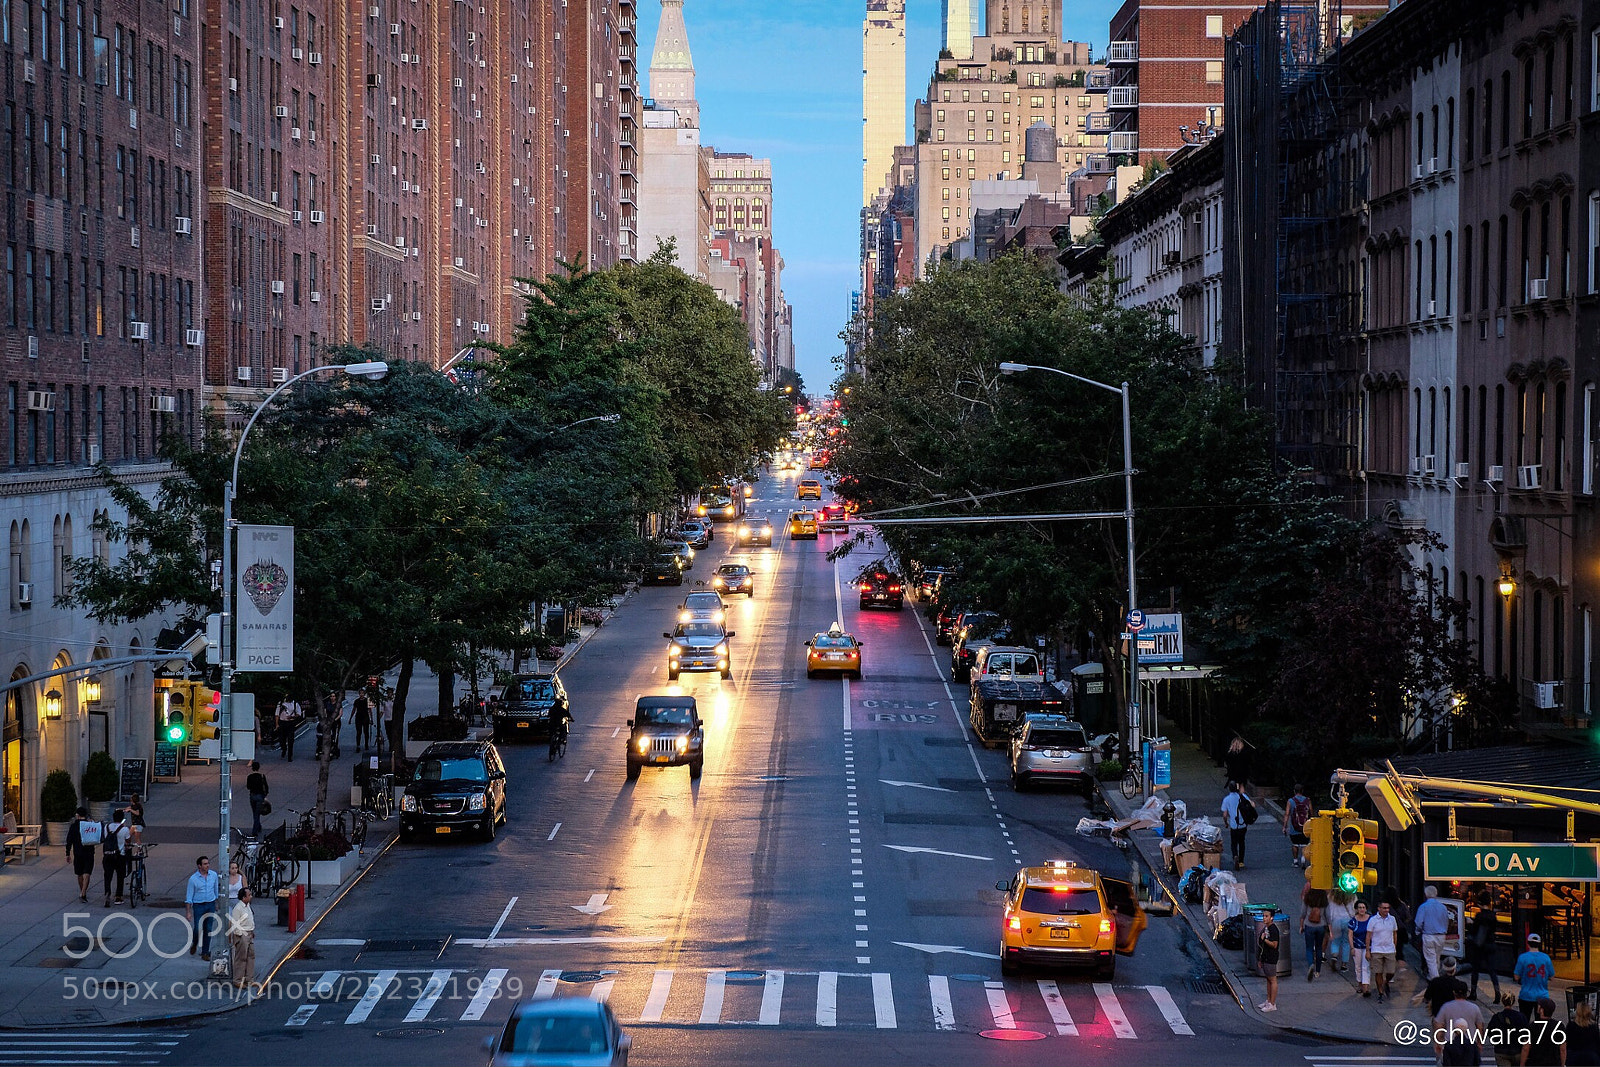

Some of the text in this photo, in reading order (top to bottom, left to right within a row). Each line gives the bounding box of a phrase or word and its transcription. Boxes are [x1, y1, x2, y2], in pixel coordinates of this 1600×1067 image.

[252, 531, 279, 542] NYC
[242, 623, 288, 631] SAMARAS
[248, 655, 280, 665] PACE
[1474, 852, 1540, 872] 10 Av
[1527, 963, 1546, 979] 24
